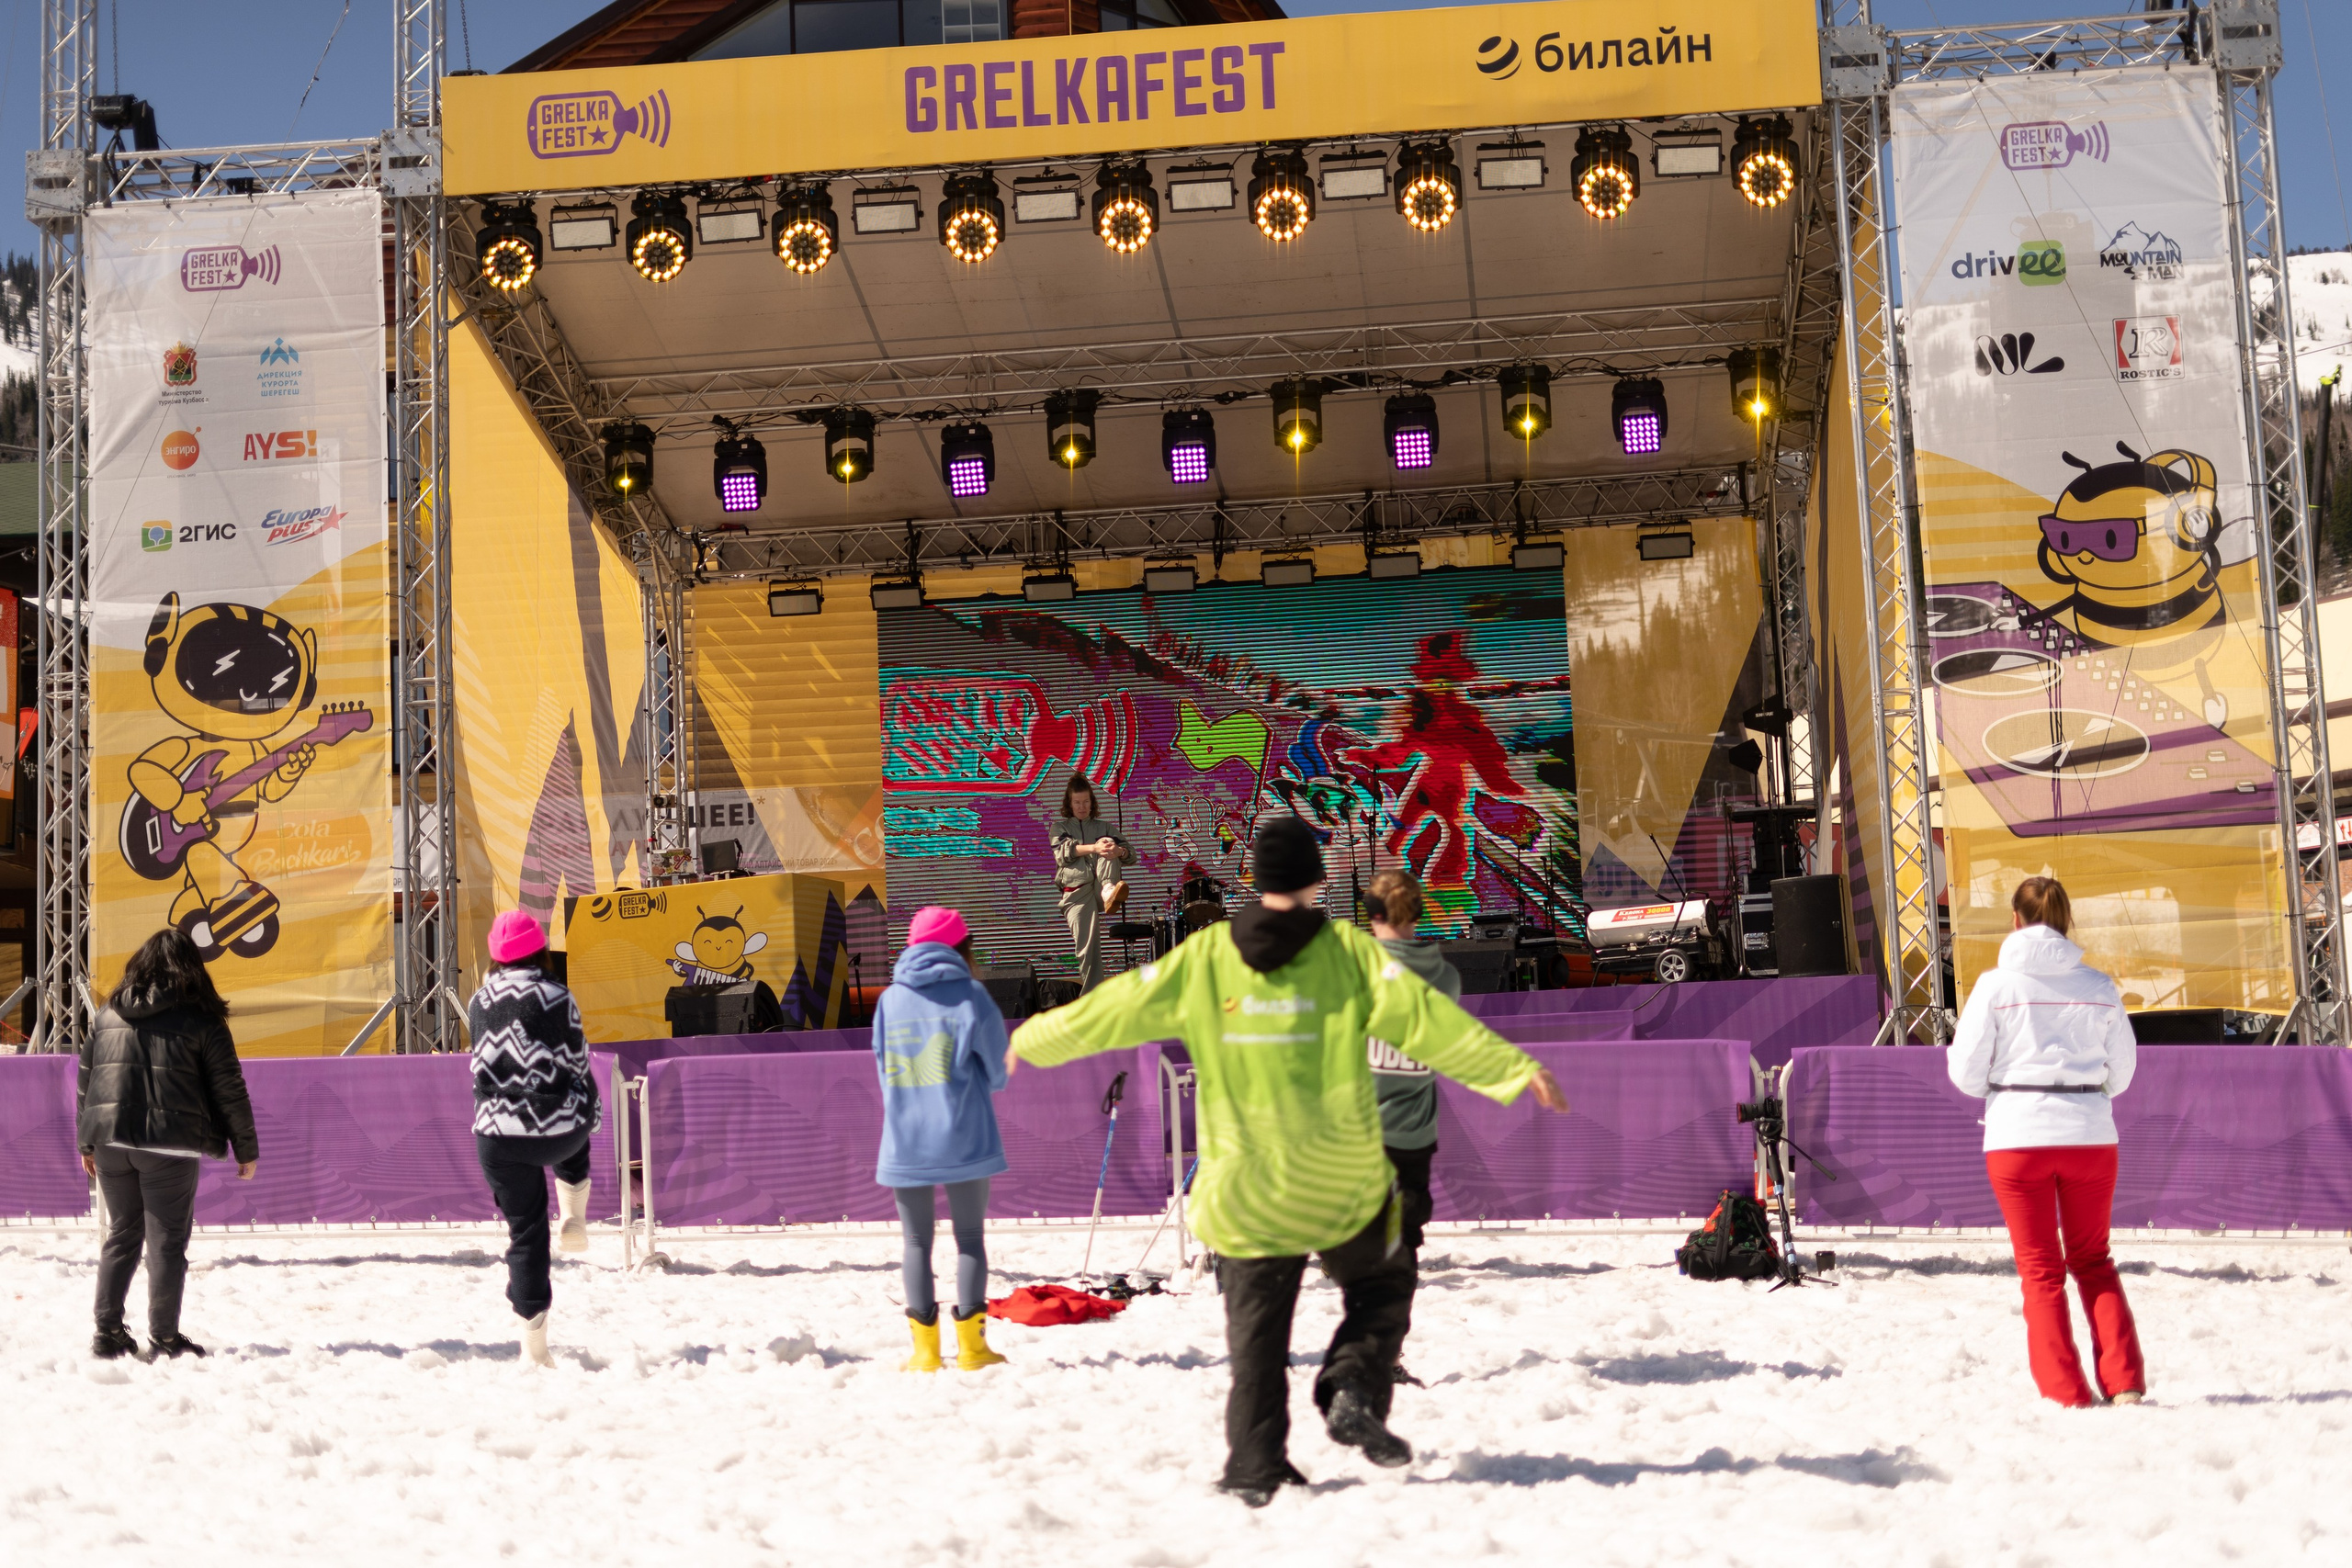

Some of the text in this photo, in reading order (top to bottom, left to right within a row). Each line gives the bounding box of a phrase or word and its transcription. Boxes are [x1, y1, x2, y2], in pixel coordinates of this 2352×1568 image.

[1534, 26, 1712, 73] билайн
[904, 41, 1285, 133] GRELKAFEST
[541, 99, 609, 125] GRELKA
[542, 125, 588, 150] FEST
[2010, 127, 2063, 146] GRELKA
[2012, 146, 2046, 164] FEST
[190, 252, 238, 269] GRELKA
[1951, 248, 2066, 279] drivee
[2099, 249, 2182, 268] MOUNTAIN
[191, 269, 222, 286] FEST
[2147, 265, 2185, 280] MAN
[257, 370, 302, 379] ДИРЕКЦИЯ
[2120, 367, 2182, 379] ROSTIC'S
[261, 379, 299, 388] КУРОРТА
[261, 388, 300, 397] ШЕРЕГЕШ
[165, 445, 197, 457] энгиро
[243, 430, 317, 461] AYS!
[179, 523, 237, 543] 2ГИС
[623, 896, 647, 907] GRELKA
[623, 906, 639, 916] FEST
